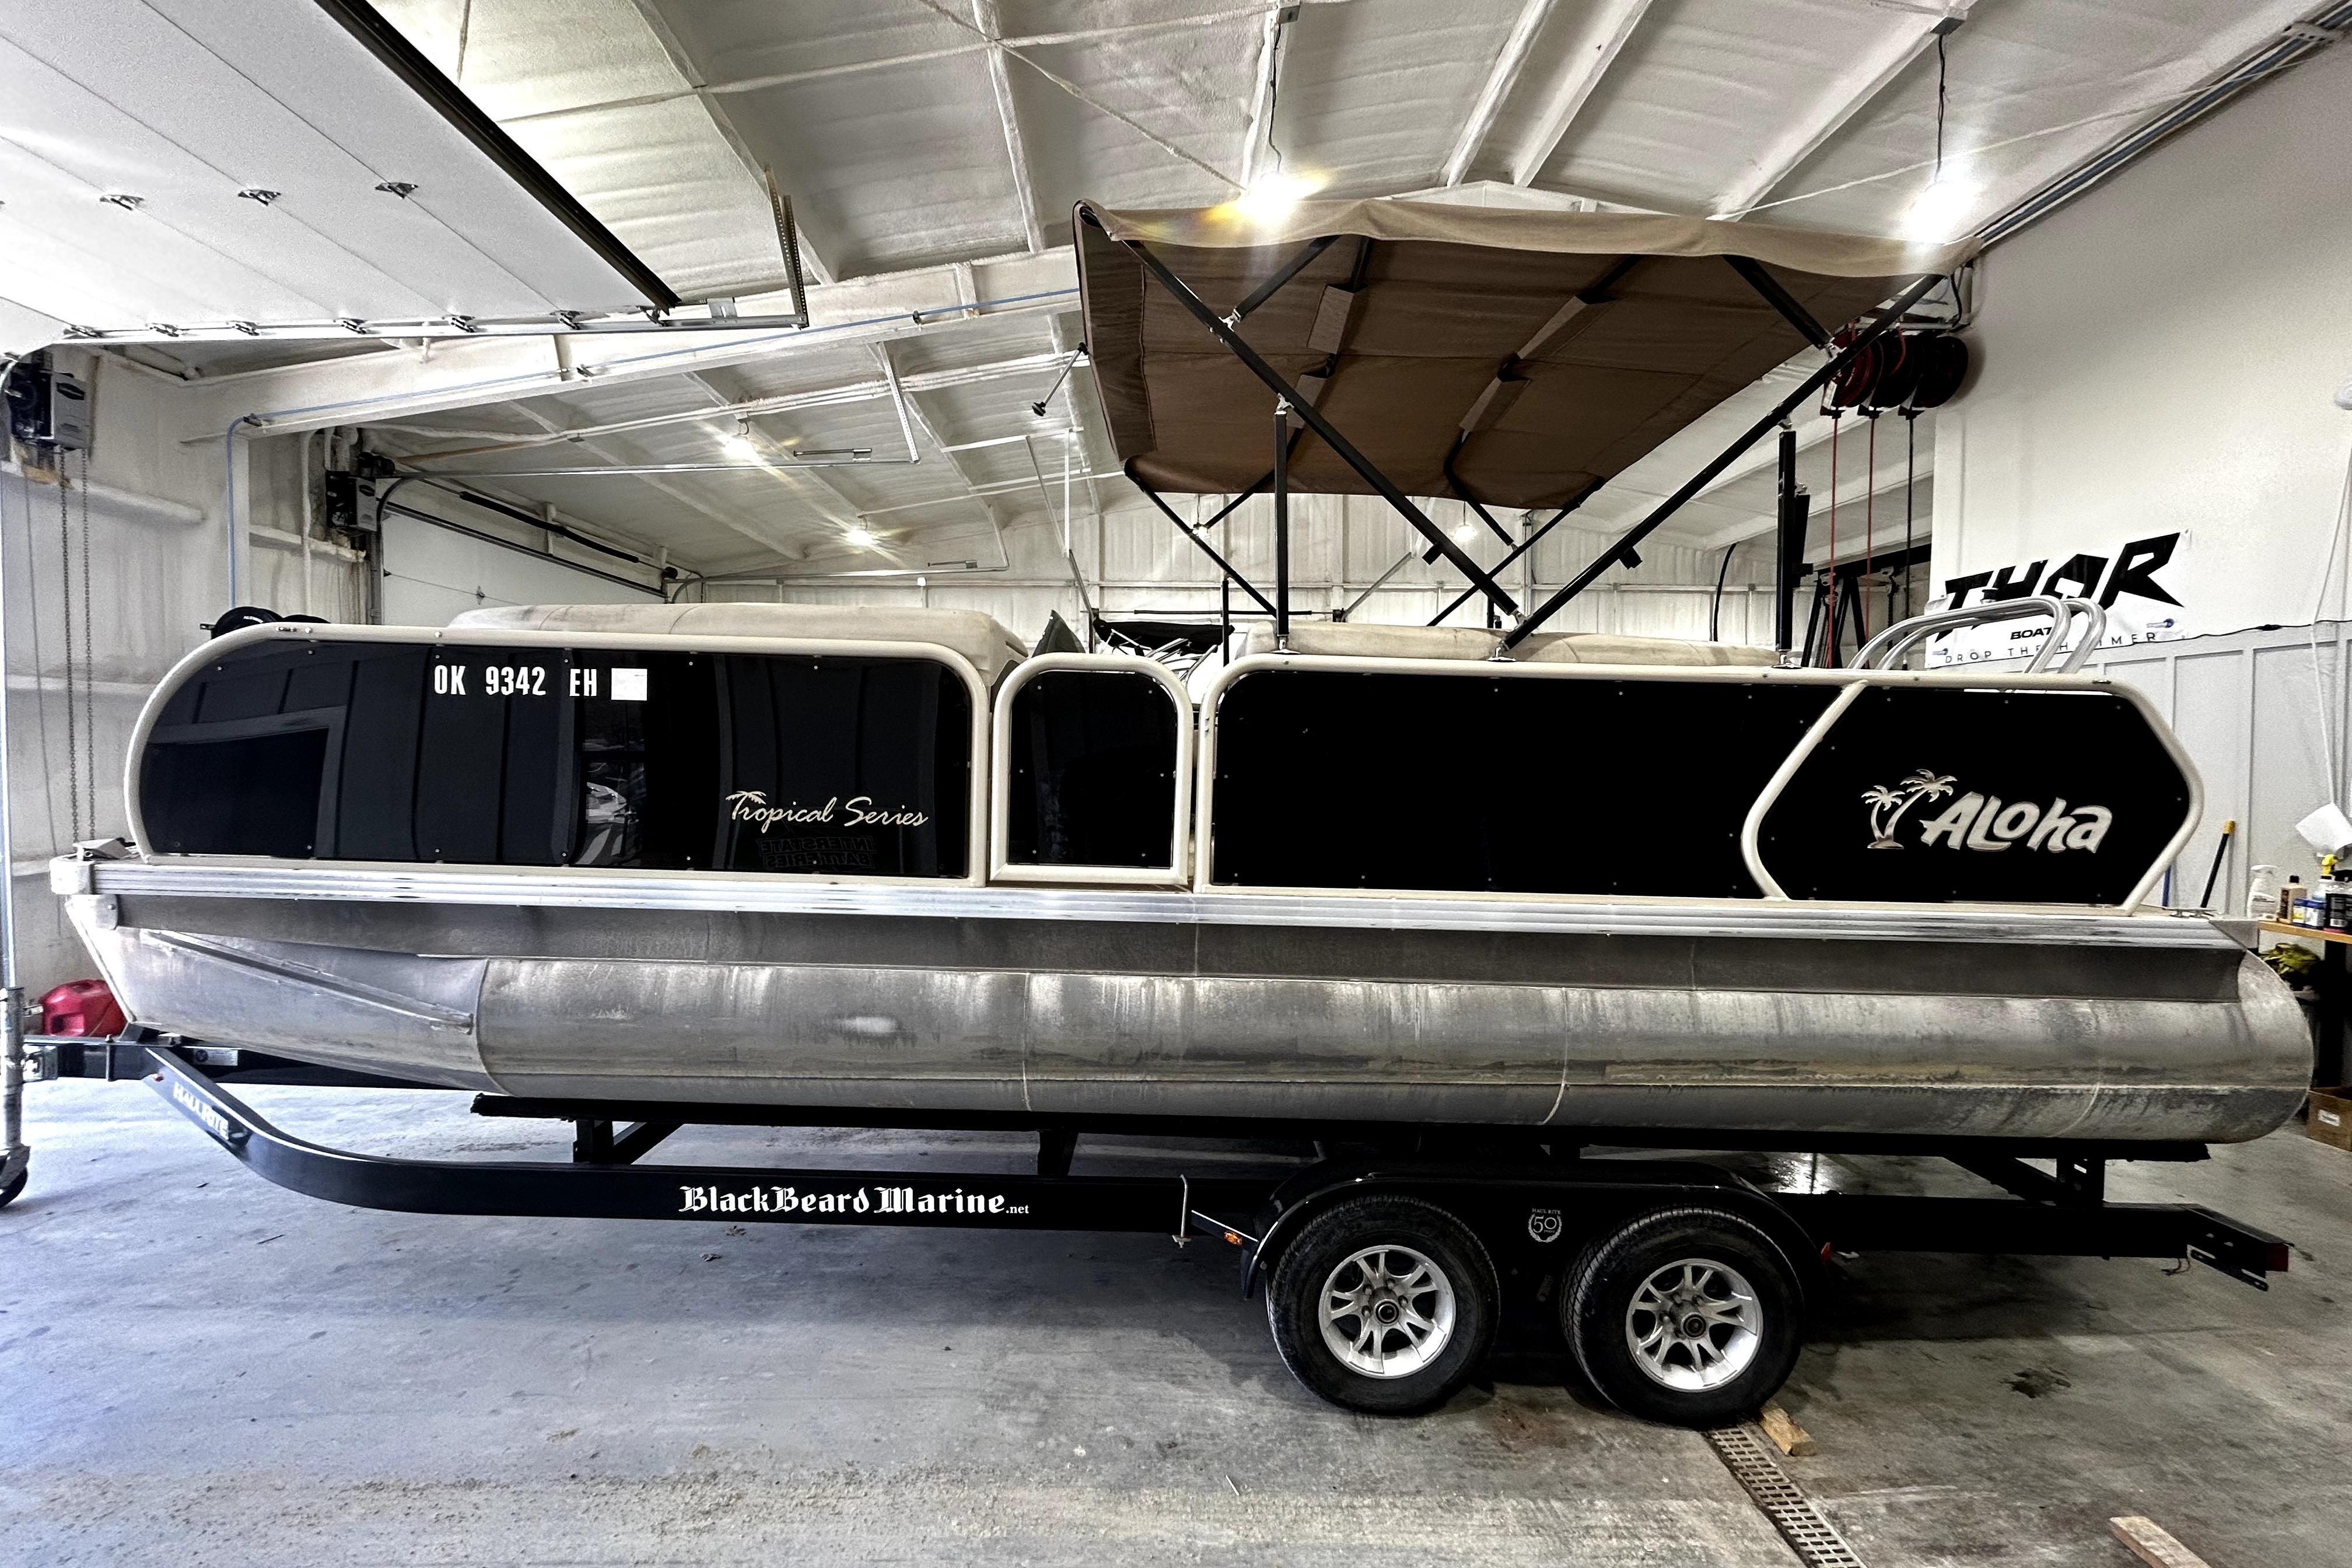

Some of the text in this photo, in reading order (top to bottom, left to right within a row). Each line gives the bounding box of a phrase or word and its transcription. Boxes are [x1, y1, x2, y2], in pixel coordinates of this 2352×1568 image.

[1945, 650, 1992, 664] DROP
[2059, 632, 2156, 651] HMER
[434, 664, 597, 696] OK 9342 EH
[725, 790, 929, 834] Tropical Series
[678, 1186, 870, 1213] BlackBeard
[1532, 1214, 1557, 1233] 50
